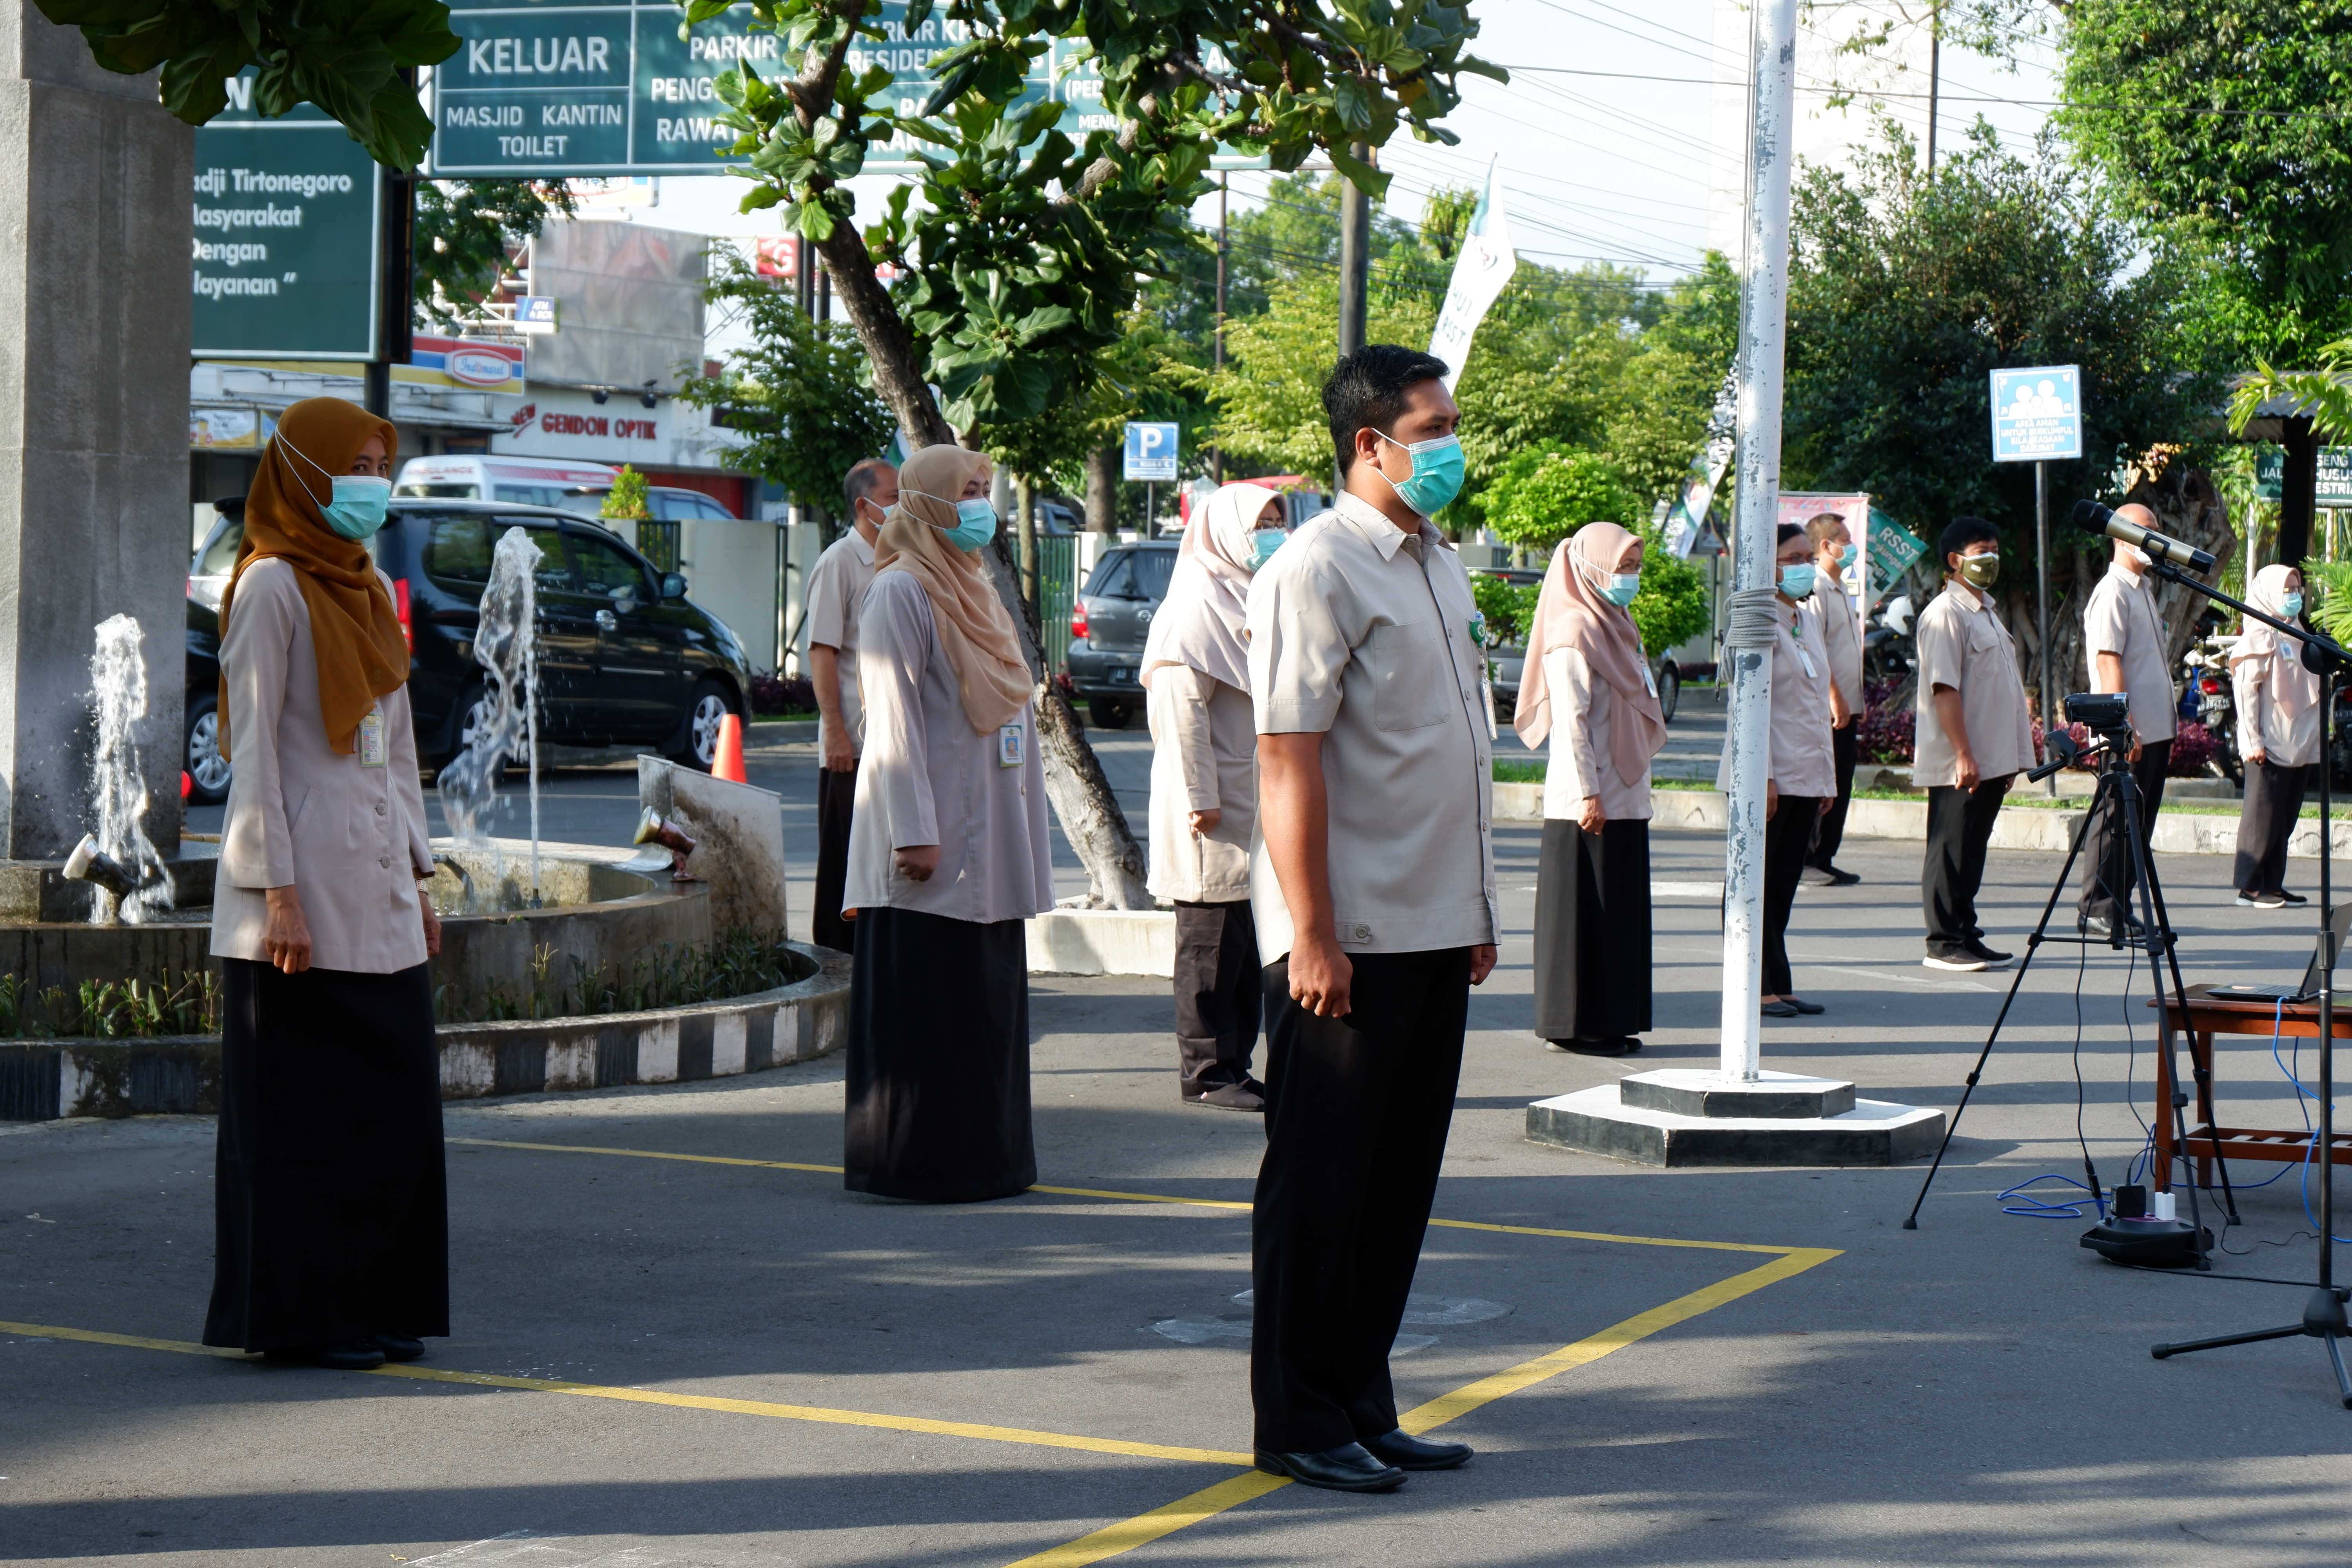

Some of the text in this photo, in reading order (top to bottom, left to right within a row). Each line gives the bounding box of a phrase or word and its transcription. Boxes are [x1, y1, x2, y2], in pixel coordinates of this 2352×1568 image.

[469, 36, 609, 73] KELUAR
[690, 35, 778, 60] PARKIR
[446, 104, 621, 126] MASJID KANTIN
[1078, 114, 1120, 129] MENU
[498, 135, 567, 156] TOILET
[231, 168, 352, 198] Tirtonegoro
[193, 202, 301, 232] asyarakat
[194, 270, 278, 301] layanan
[532, 301, 549, 310] ATM
[541, 412, 657, 439] GENDON OPTIK
[2000, 426, 2074, 437] UNTUK BERKUMPUL
[2014, 420, 2035, 428] AREA
[1140, 427, 1163, 458] P
[2020, 443, 2055, 452] DARURAT
[2261, 467, 2283, 479] JAL
[2316, 482, 2352, 495] ESTRI
[1879, 526, 1920, 561] RSST
